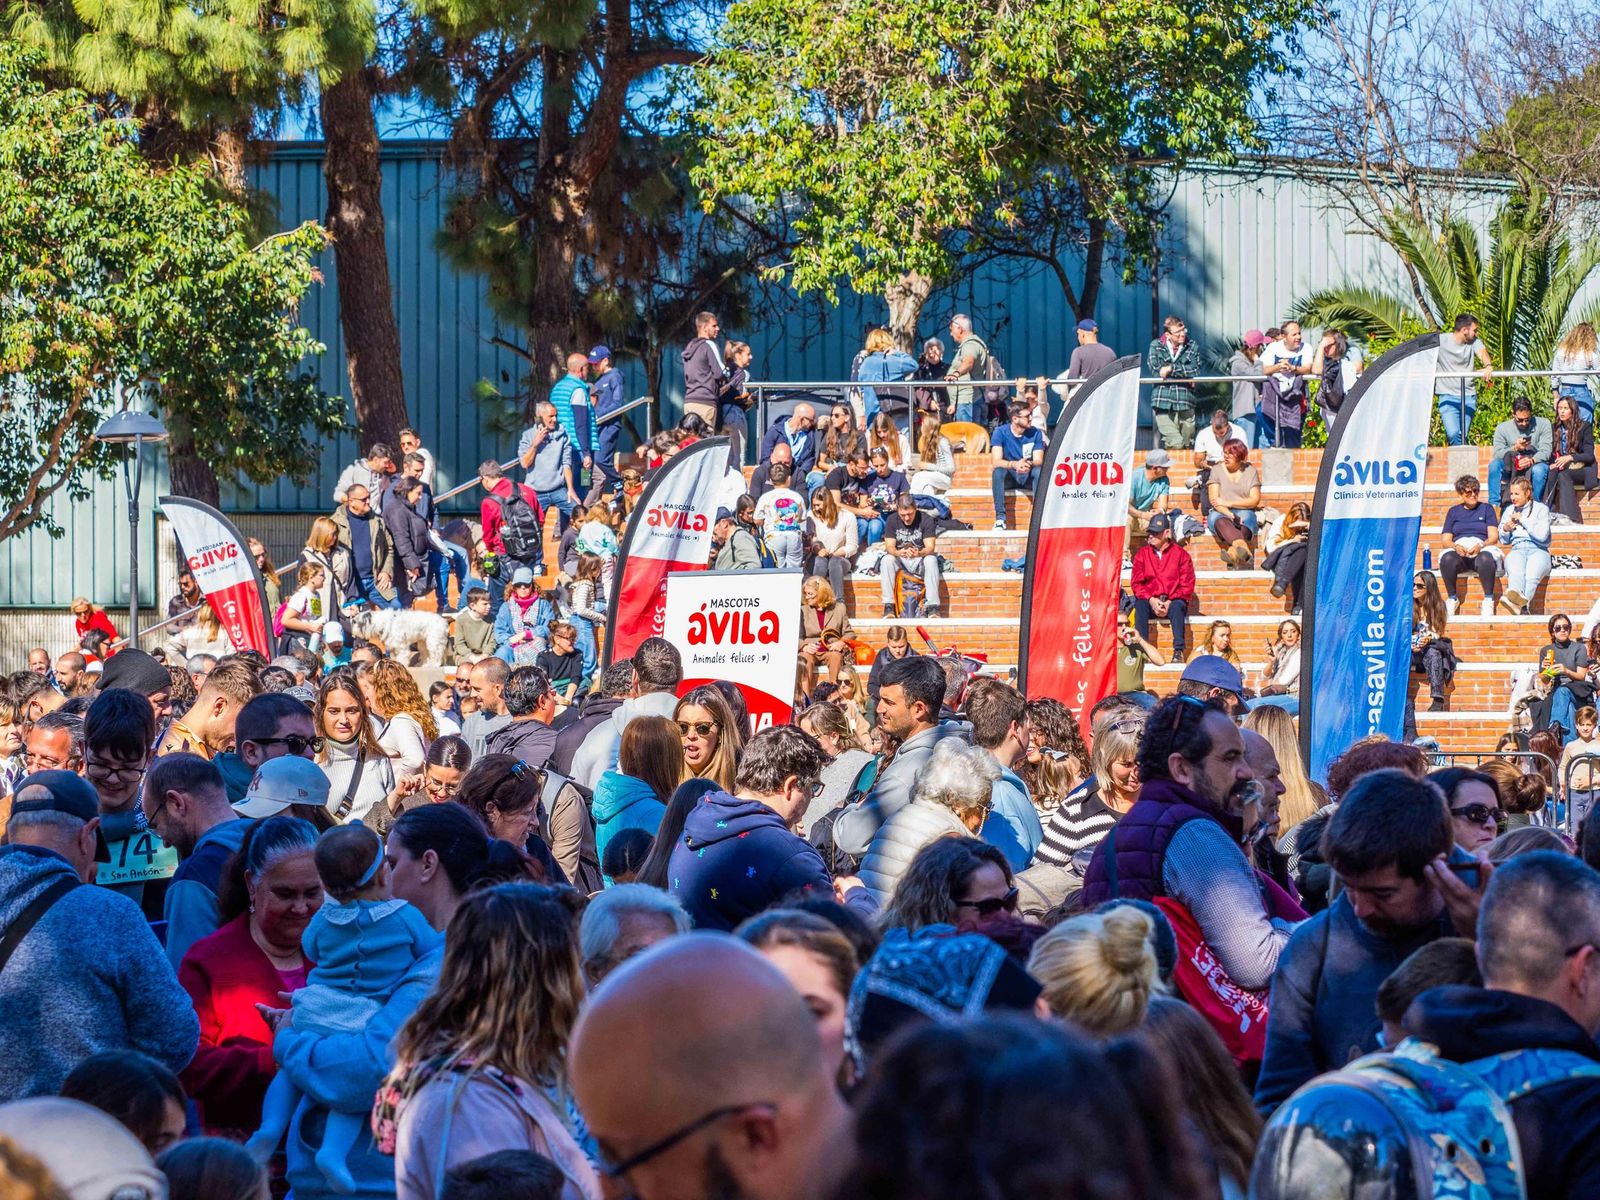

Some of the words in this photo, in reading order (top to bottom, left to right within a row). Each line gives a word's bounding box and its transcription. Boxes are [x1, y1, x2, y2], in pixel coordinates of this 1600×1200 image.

[1365, 490, 1419, 499] Veterinarias
[710, 597, 760, 608] MASCOTAS
[652, 605, 666, 639] ices
[1072, 588, 1091, 668] felices
[692, 651, 726, 664] Animales
[730, 651, 755, 664] felices
[111, 869, 128, 880] San
